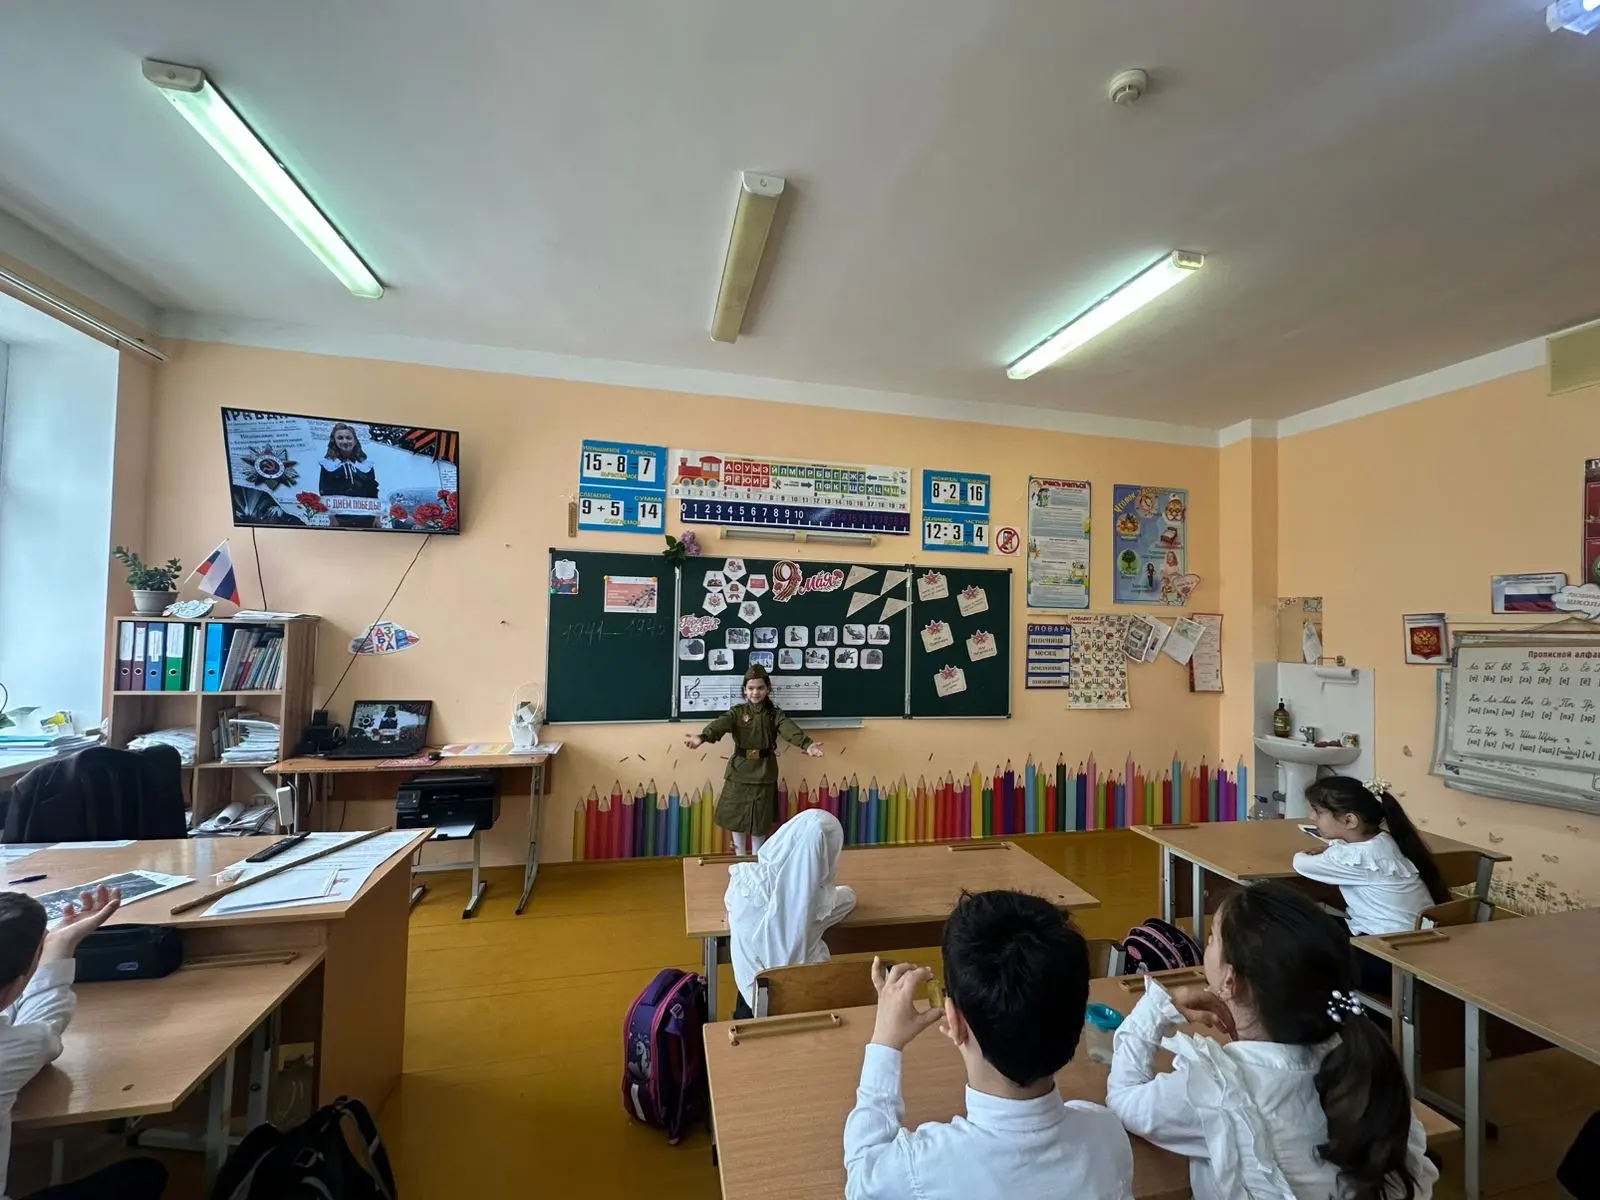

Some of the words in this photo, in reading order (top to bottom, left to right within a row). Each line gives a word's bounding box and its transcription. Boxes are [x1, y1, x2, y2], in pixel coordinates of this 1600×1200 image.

[585, 453, 601, 470] 15
[617, 456, 625, 473] 8
[643, 458, 651, 474] 7
[876, 486, 882, 495] Ц
[933, 483, 940, 498] 8
[950, 484, 956, 499] 2
[970, 486, 982, 500] 16
[582, 500, 591, 514] 9
[611, 502, 620, 516] 5
[640, 504, 658, 518] 14
[681, 504, 686, 512] 0
[694, 504, 697, 512] 1
[705, 504, 710, 513] 2
[716, 504, 721, 513] 3
[728, 506, 733, 514] 4
[740, 506, 744, 515] 5
[751, 507, 756, 516] 6
[762, 508, 767, 516] 7
[774, 508, 778, 517] 8
[785, 509, 790, 518] 9
[926, 523, 941, 539] 12
[953, 525, 960, 540] 3
[976, 527, 983, 541] 4
[774, 560, 801, 601] 9
[1528, 651, 1572, 659] Прописной
[1574, 651, 1600, 659] алфа
